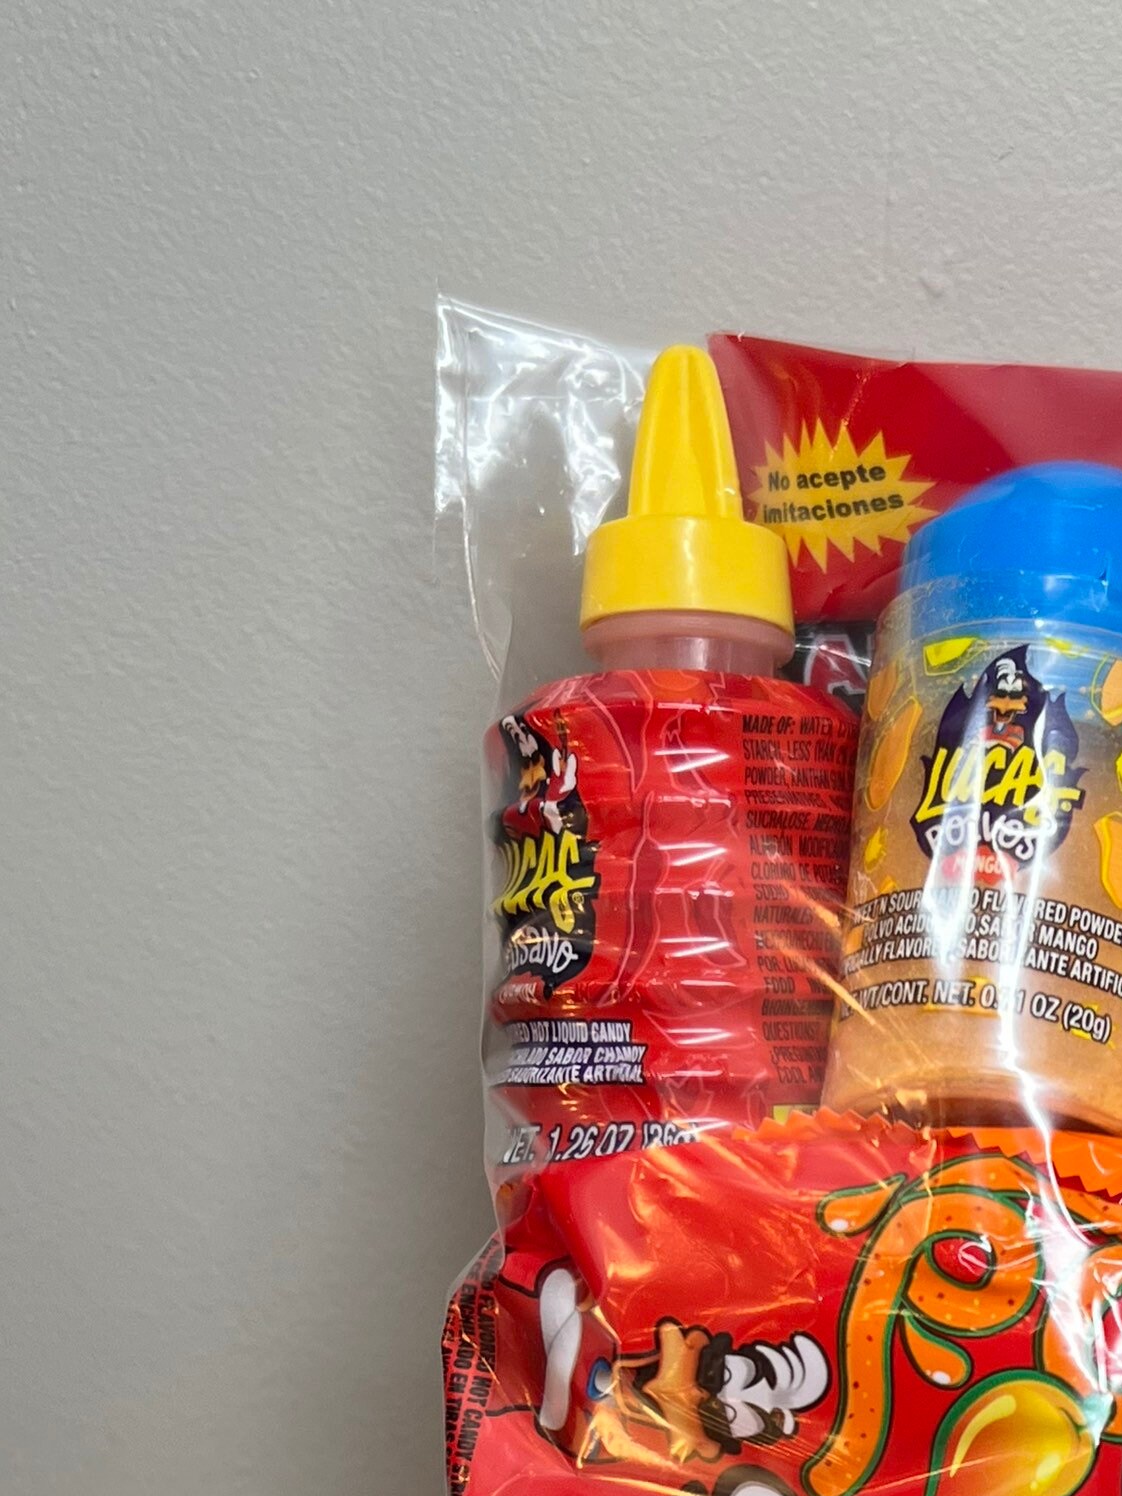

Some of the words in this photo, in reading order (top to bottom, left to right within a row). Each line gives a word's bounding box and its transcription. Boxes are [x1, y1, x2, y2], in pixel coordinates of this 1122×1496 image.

[769, 471, 790, 491] No
[797, 464, 886, 490] acepte
[763, 493, 904, 524] imitaciones
[1038, 924, 1098, 961] MANGO
[933, 979, 975, 1006] NET.
[1030, 993, 1061, 1022] OZ
[1063, 1002, 1112, 1043] (20g)
[551, 1020, 589, 1045] LIQUID
[591, 1021, 632, 1044] CANDY
[594, 1045, 647, 1064] CHAMOY
[468, 1375, 494, 1406] HOT
[455, 1408, 483, 1463] CANDY
